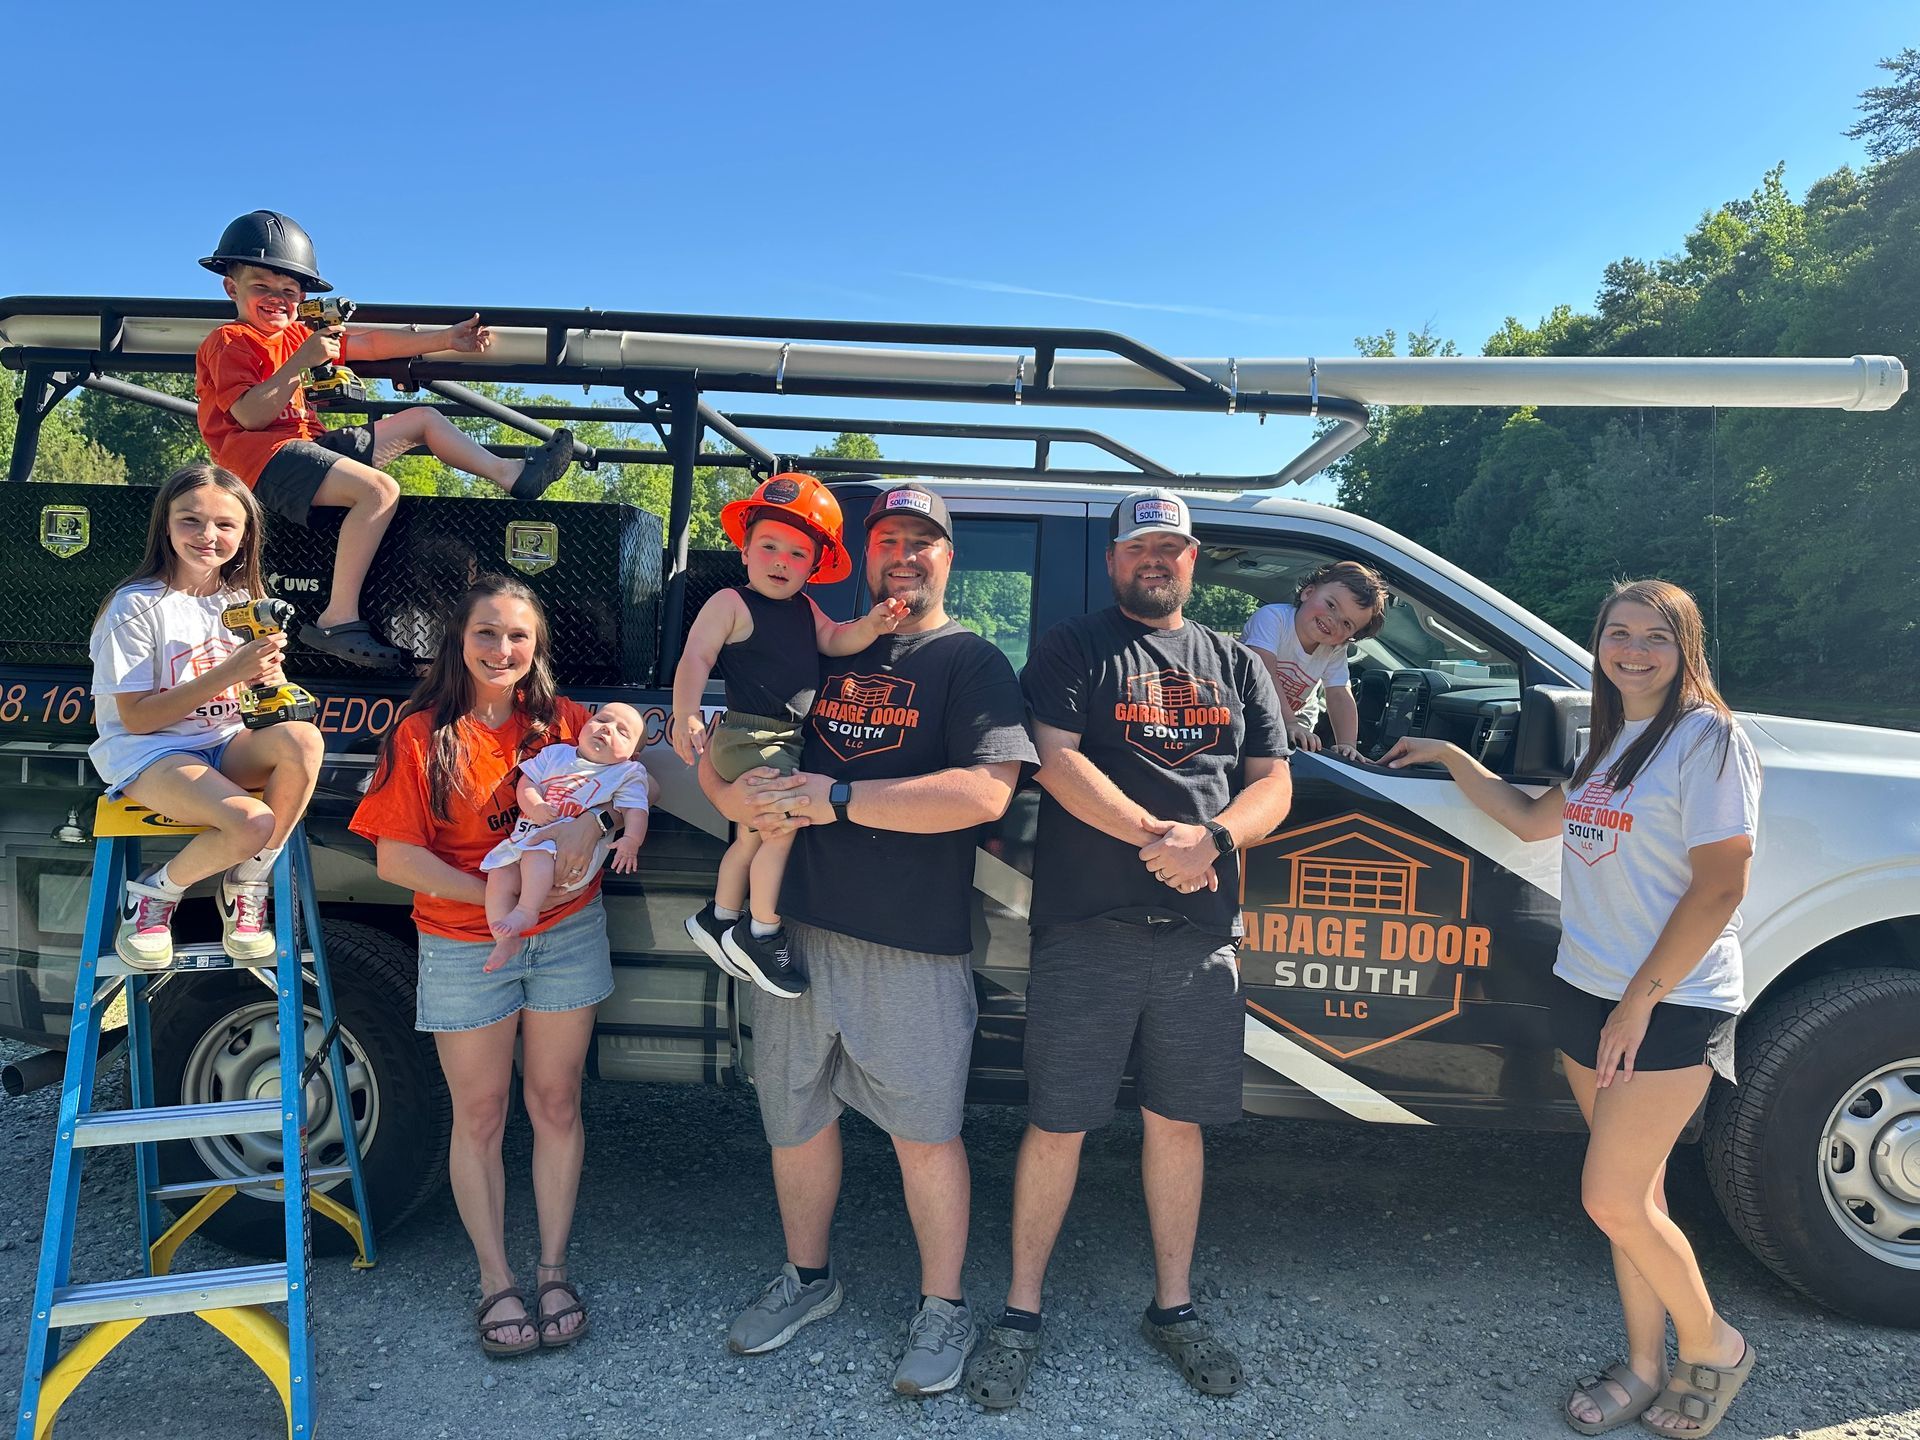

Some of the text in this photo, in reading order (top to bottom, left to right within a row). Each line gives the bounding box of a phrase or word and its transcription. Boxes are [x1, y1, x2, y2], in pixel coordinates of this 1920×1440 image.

[889, 491, 912, 500] GARAGE
[890, 499, 927, 510] SOUTH LLC
[1136, 502, 1178, 513] GARAGE DOOR
[1139, 510, 1177, 521] SOUTH LLC
[284, 577, 320, 592] UWS
[0, 683, 96, 725] 8.16
[813, 698, 920, 728] ARAGE DOOR
[1115, 702, 1231, 727] GARAGE DOOR
[828, 720, 886, 739] SOUTH
[1143, 724, 1203, 740] SOUTH
[844, 738, 864, 749] LLC
[1163, 741, 1184, 750] LLC
[487, 806, 520, 832] GAR
[1563, 801, 1634, 833] RAGE DOOR
[1568, 823, 1604, 842] SOUTH
[1580, 841, 1593, 851] LLC
[1238, 911, 1492, 968] ARAGE DOOR
[1274, 960, 1418, 996] SOUTH
[1325, 999, 1369, 1019] LLC
